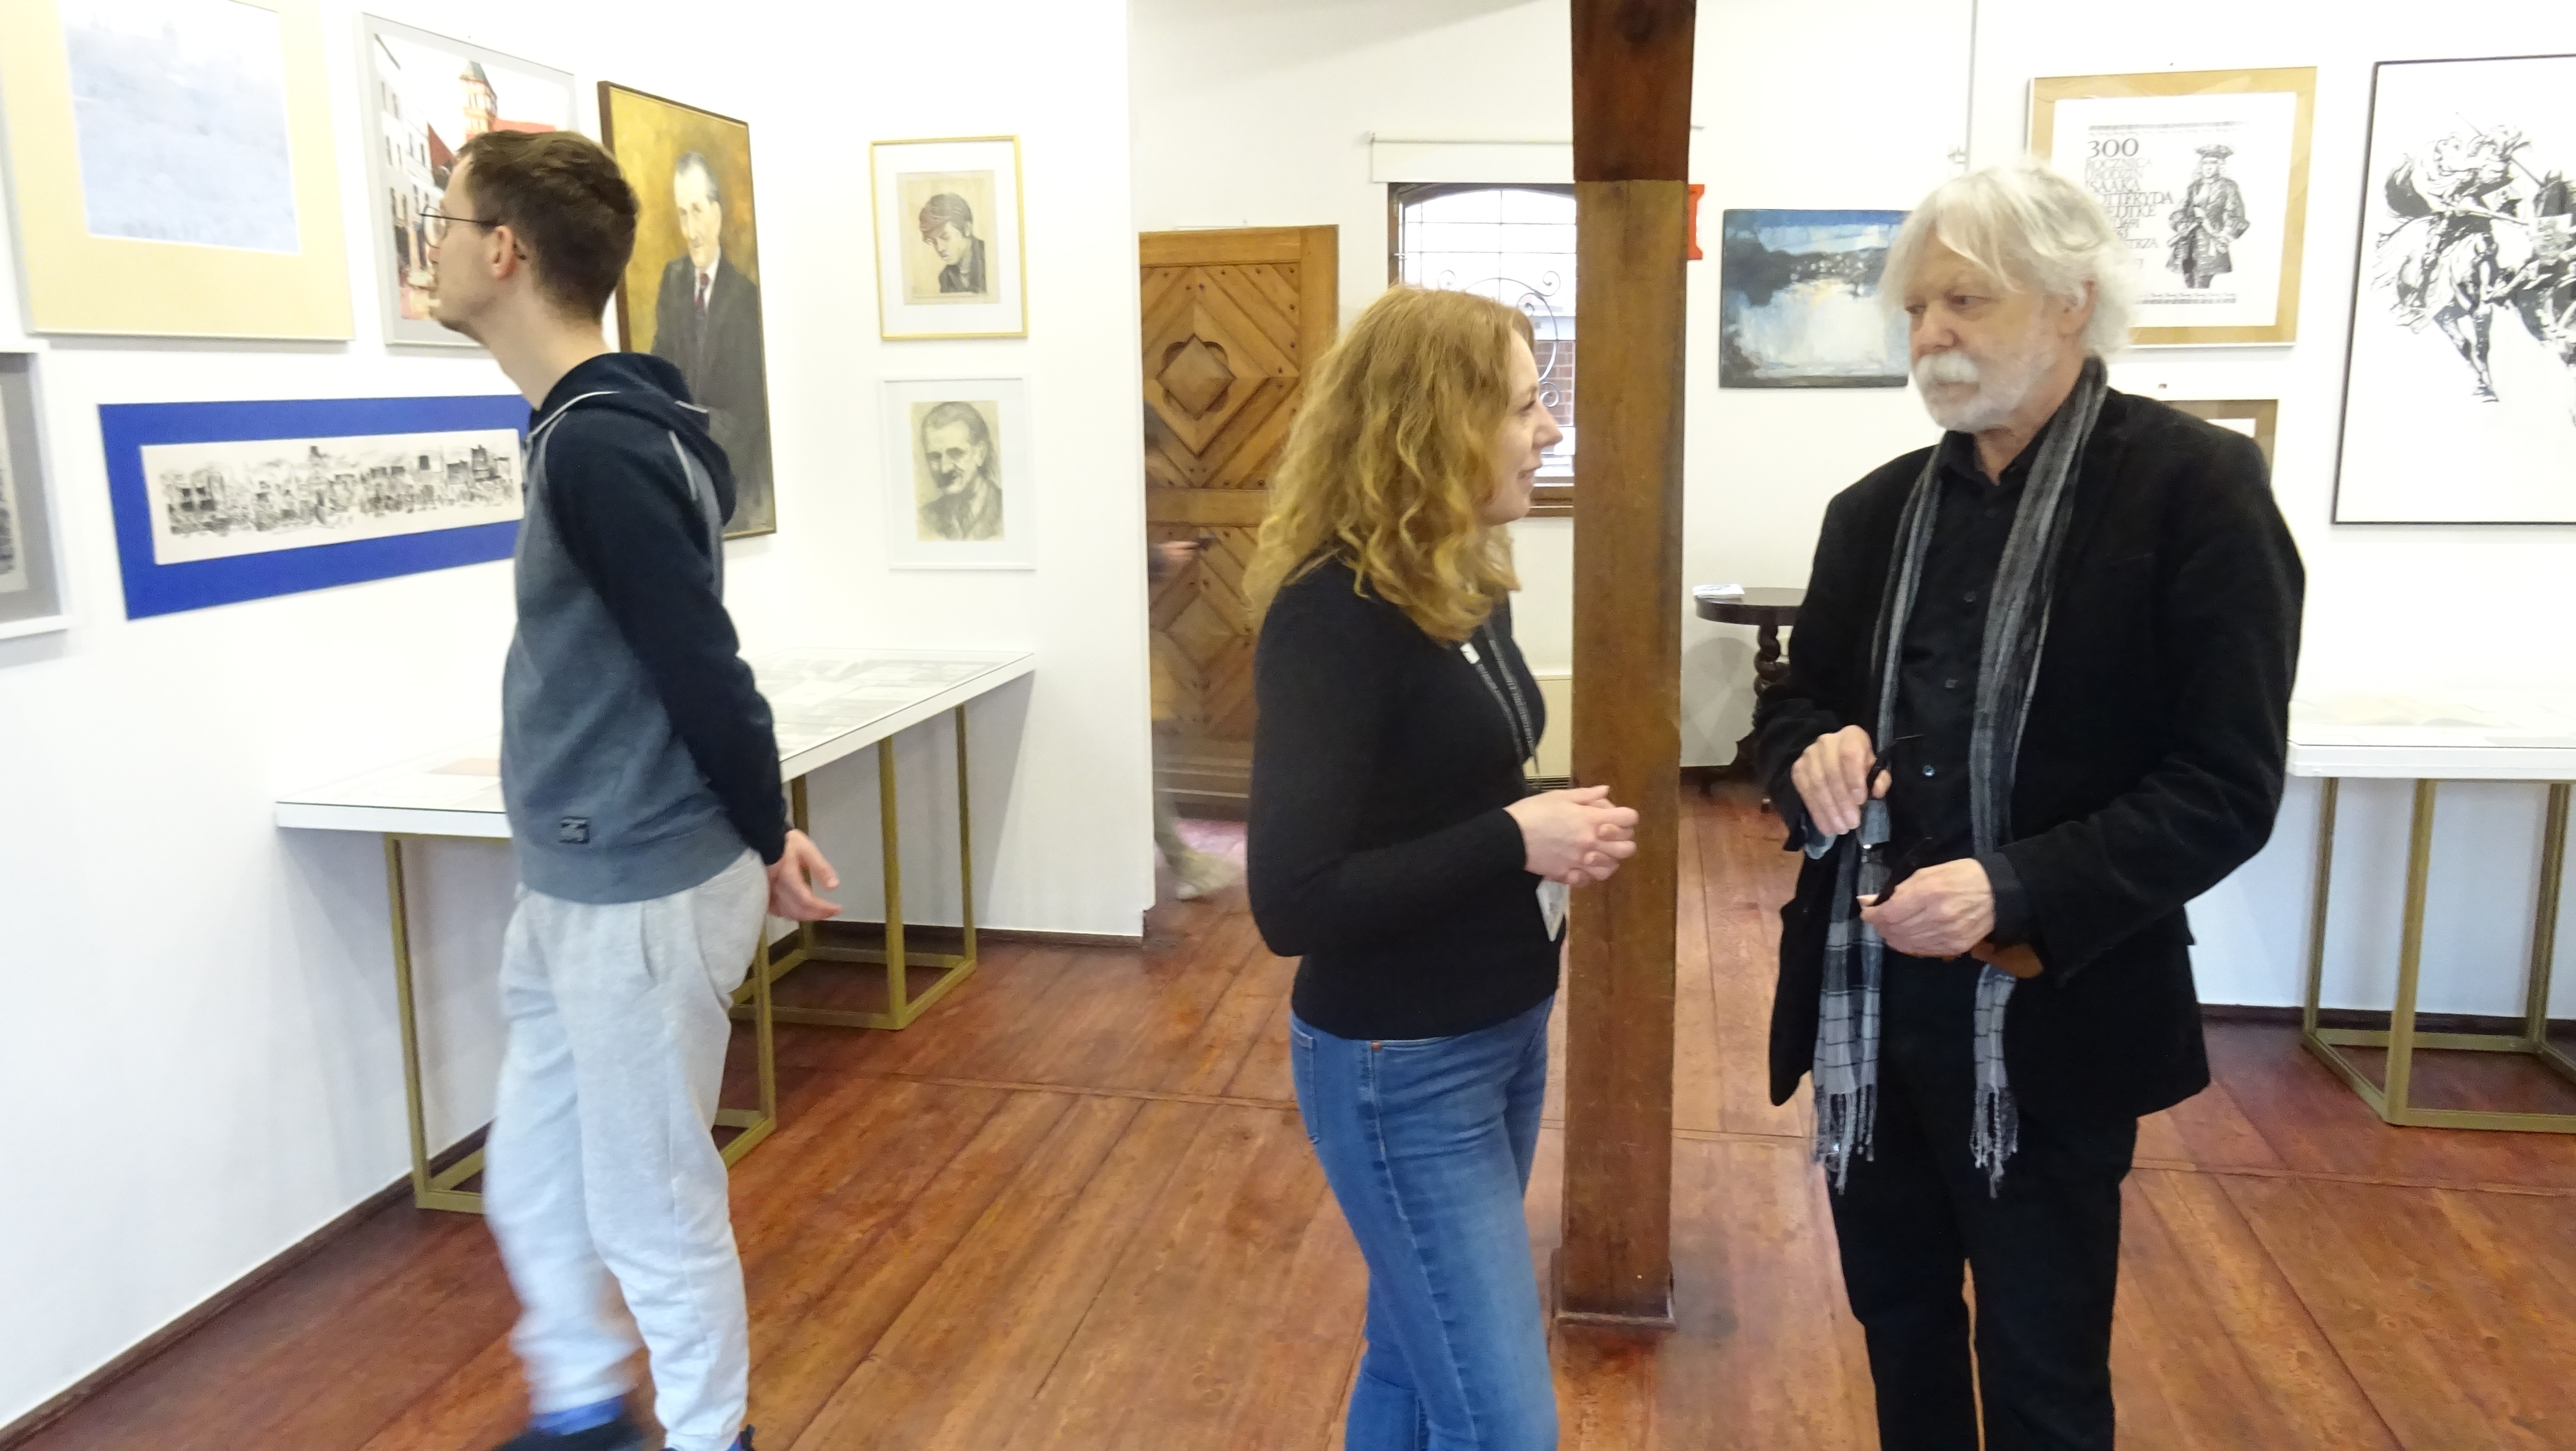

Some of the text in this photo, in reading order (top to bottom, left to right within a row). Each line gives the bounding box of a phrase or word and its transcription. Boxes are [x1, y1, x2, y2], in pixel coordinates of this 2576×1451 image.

[2087, 139, 2139, 159] 300
[2086, 158, 2154, 169] ROCZNICA
[2085, 169, 2144, 180] URODZIN
[2086, 179, 2141, 192] ISAAKA
[2096, 191, 2174, 205] OTTFRYDA
[2107, 205, 2157, 218] EDTKE
